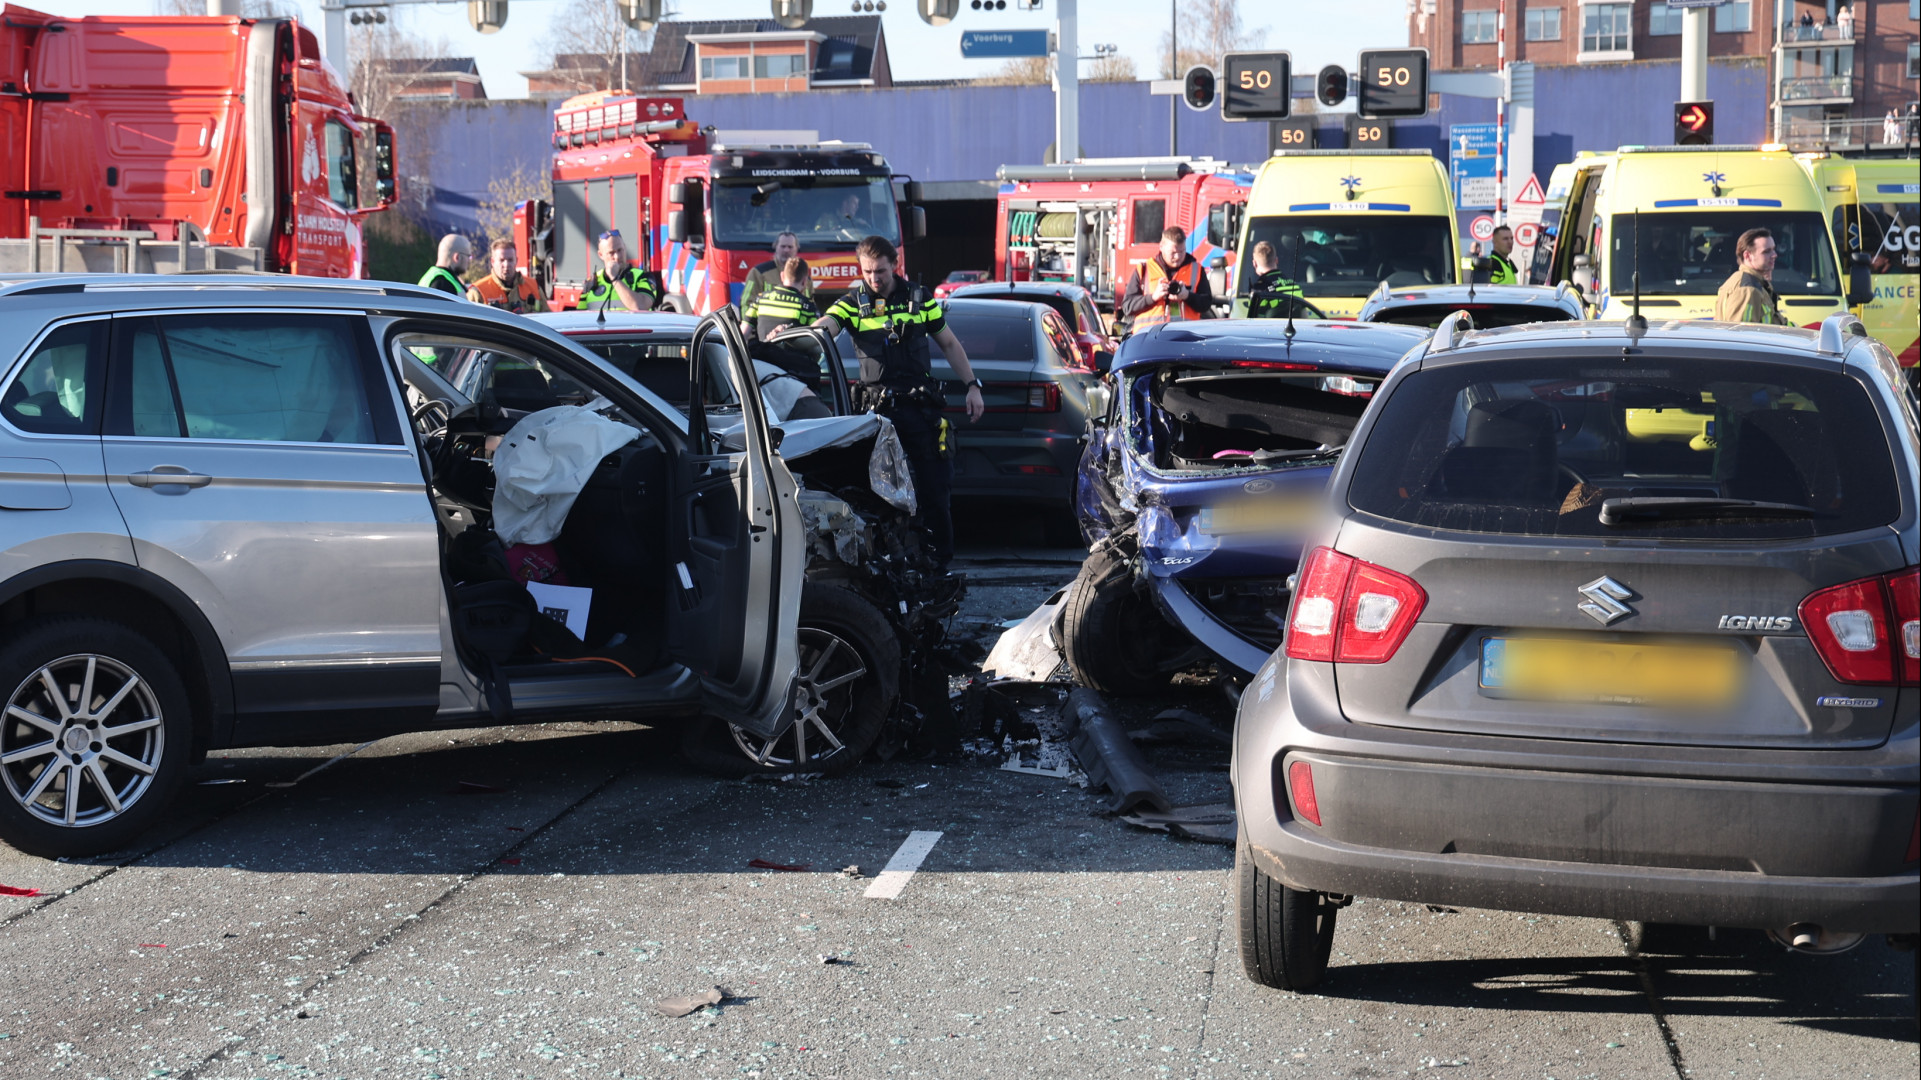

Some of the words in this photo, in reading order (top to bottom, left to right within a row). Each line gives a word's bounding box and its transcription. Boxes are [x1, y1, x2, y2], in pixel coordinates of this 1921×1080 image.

[973, 34, 1013, 44] Voorburg
[1240, 70, 1272, 89] 50
[1378, 67, 1410, 86] 50
[1281, 129, 1305, 144] 50
[1357, 126, 1381, 142] 50
[752, 169, 808, 177] LEIDSCHENDAM
[1476, 224, 1492, 234] 50
[298, 232, 342, 247] TRANSPORT
[1884, 225, 1920, 251] GG
[811, 265, 858, 277] DWEER
[1718, 614, 1793, 631] IGNIS
[1485, 667, 1502, 679] NL
[1827, 699, 1875, 707] HYBRID
